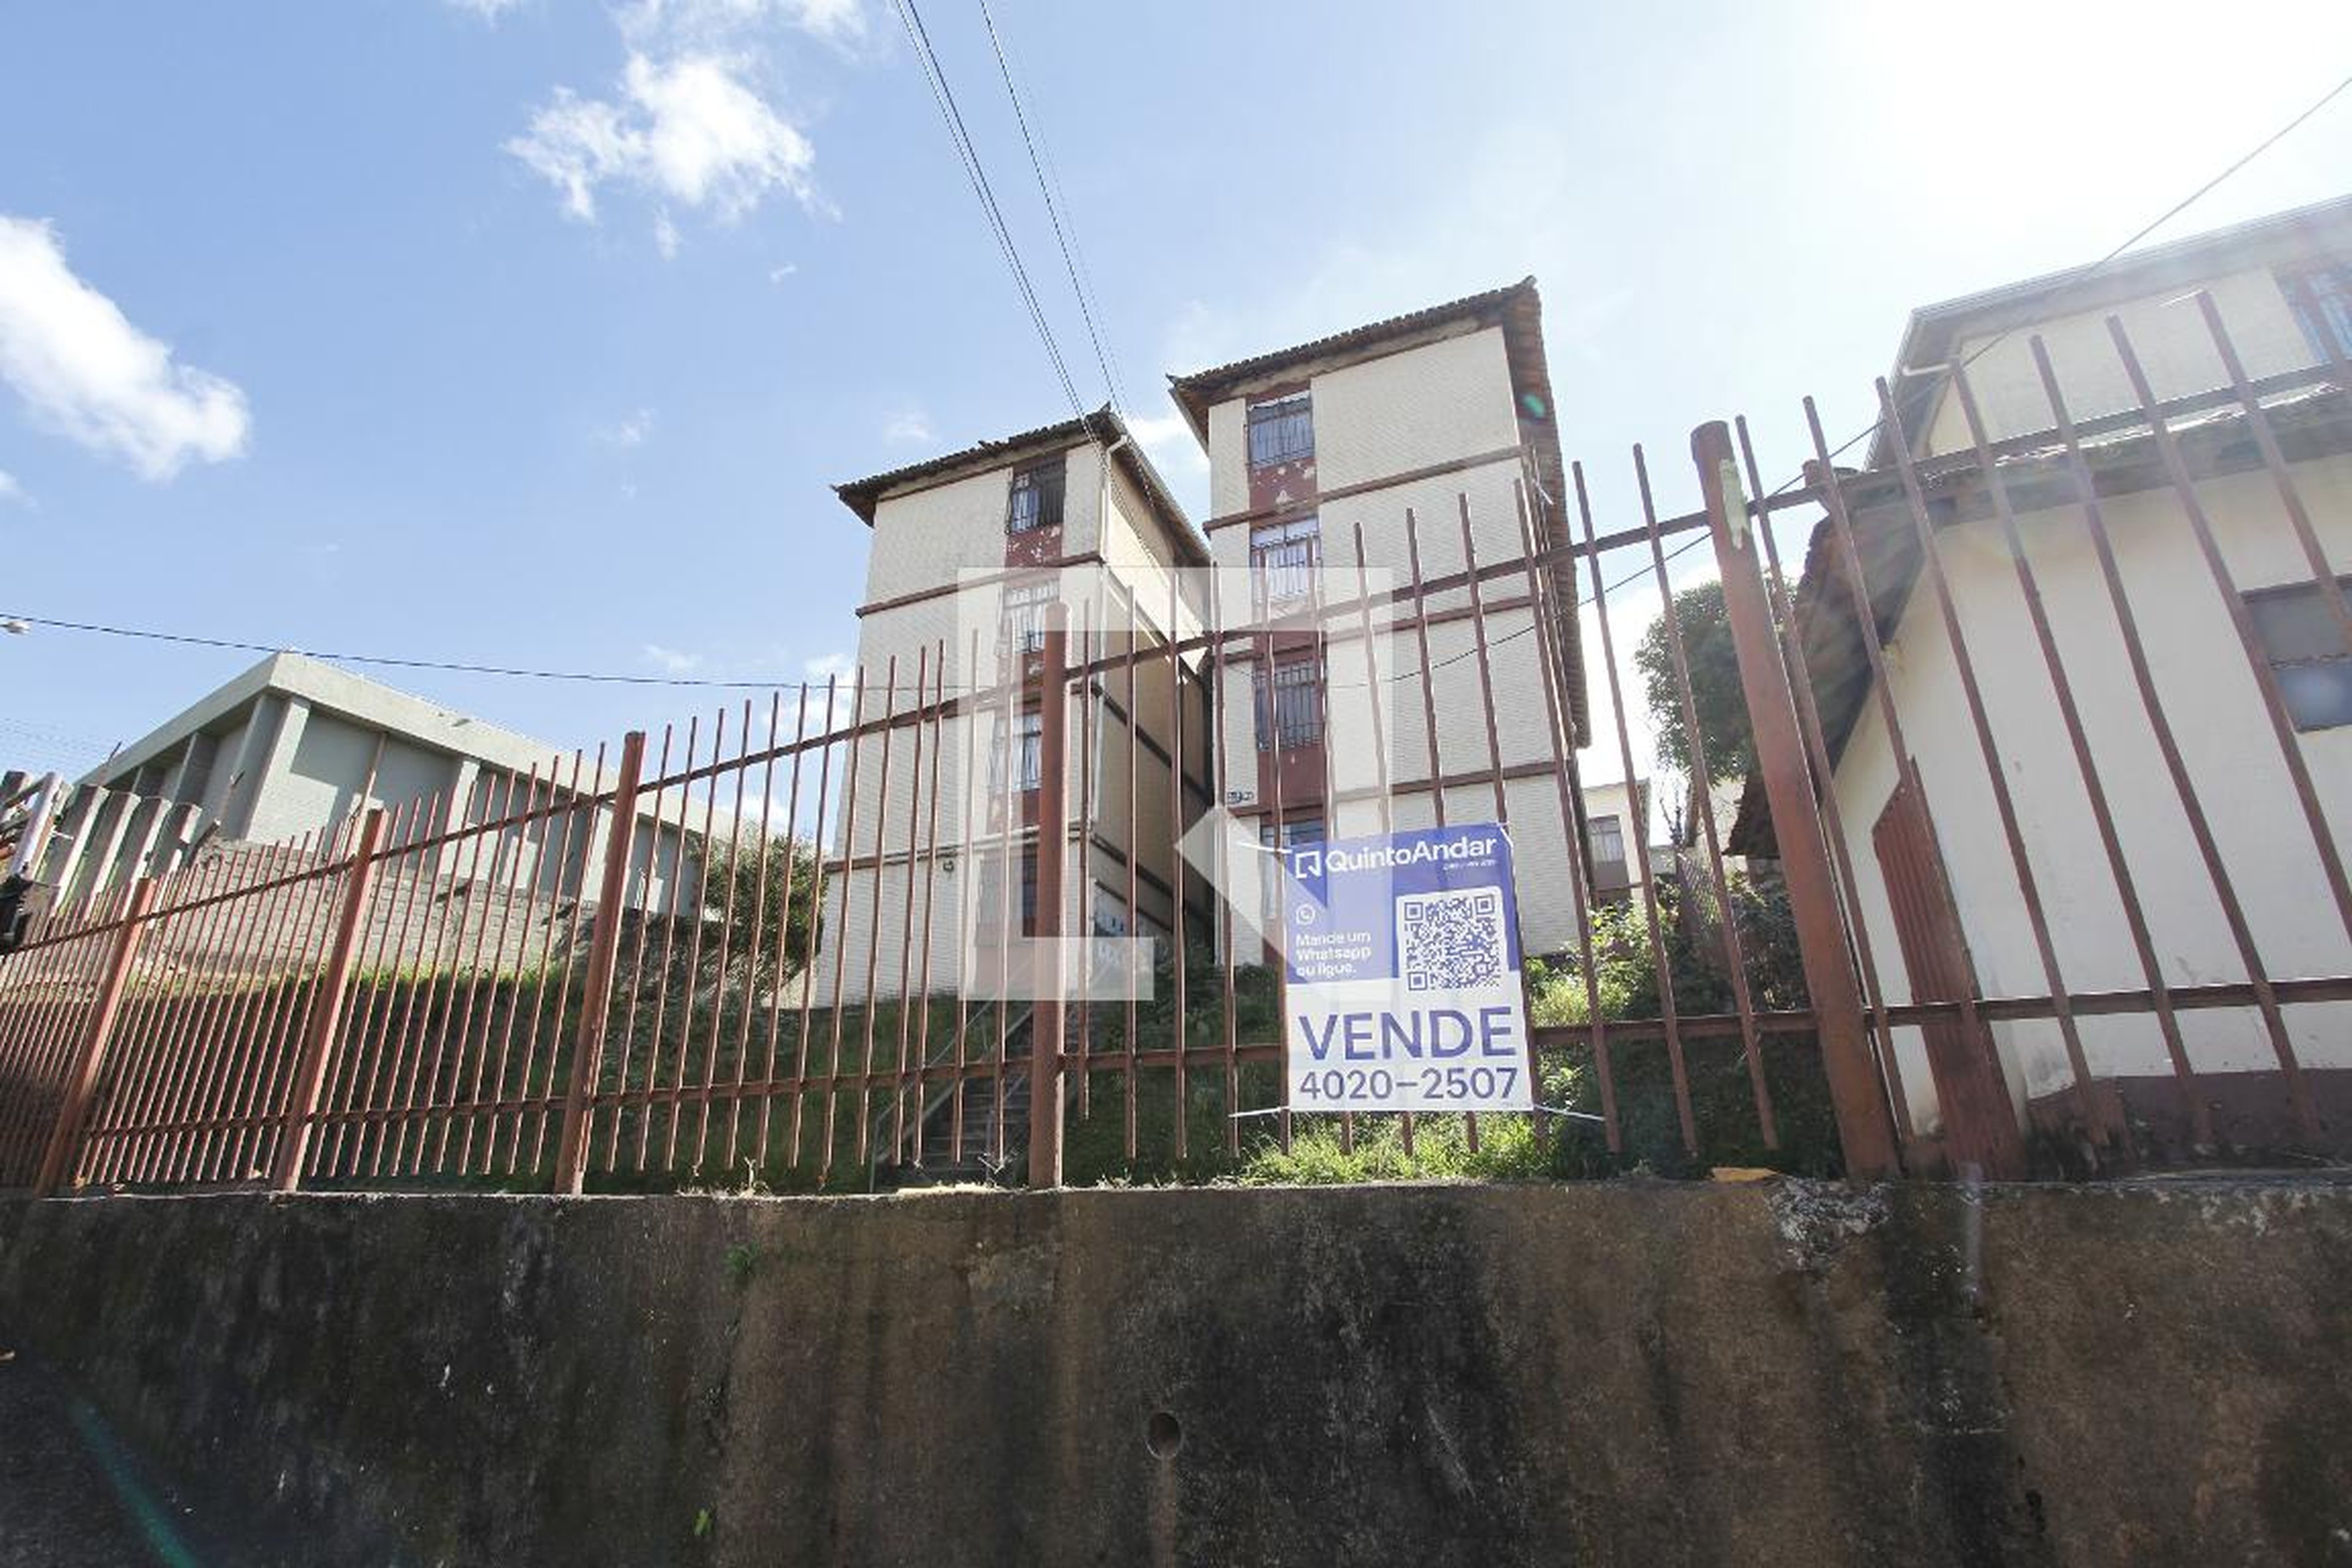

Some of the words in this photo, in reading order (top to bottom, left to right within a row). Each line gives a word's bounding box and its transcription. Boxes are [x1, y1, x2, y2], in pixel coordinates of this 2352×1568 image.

[1325, 837, 1497, 873] QuintoAndar
[1295, 932, 1345, 947] Mande
[1347, 932, 1371, 943] um
[1295, 947, 1371, 961] Whatsapp
[1296, 966, 1316, 977] ou
[1317, 962, 1357, 979] ligue.
[1298, 1006, 1517, 1061] VENDE
[1300, 1067, 1518, 1100] 4020-2507
